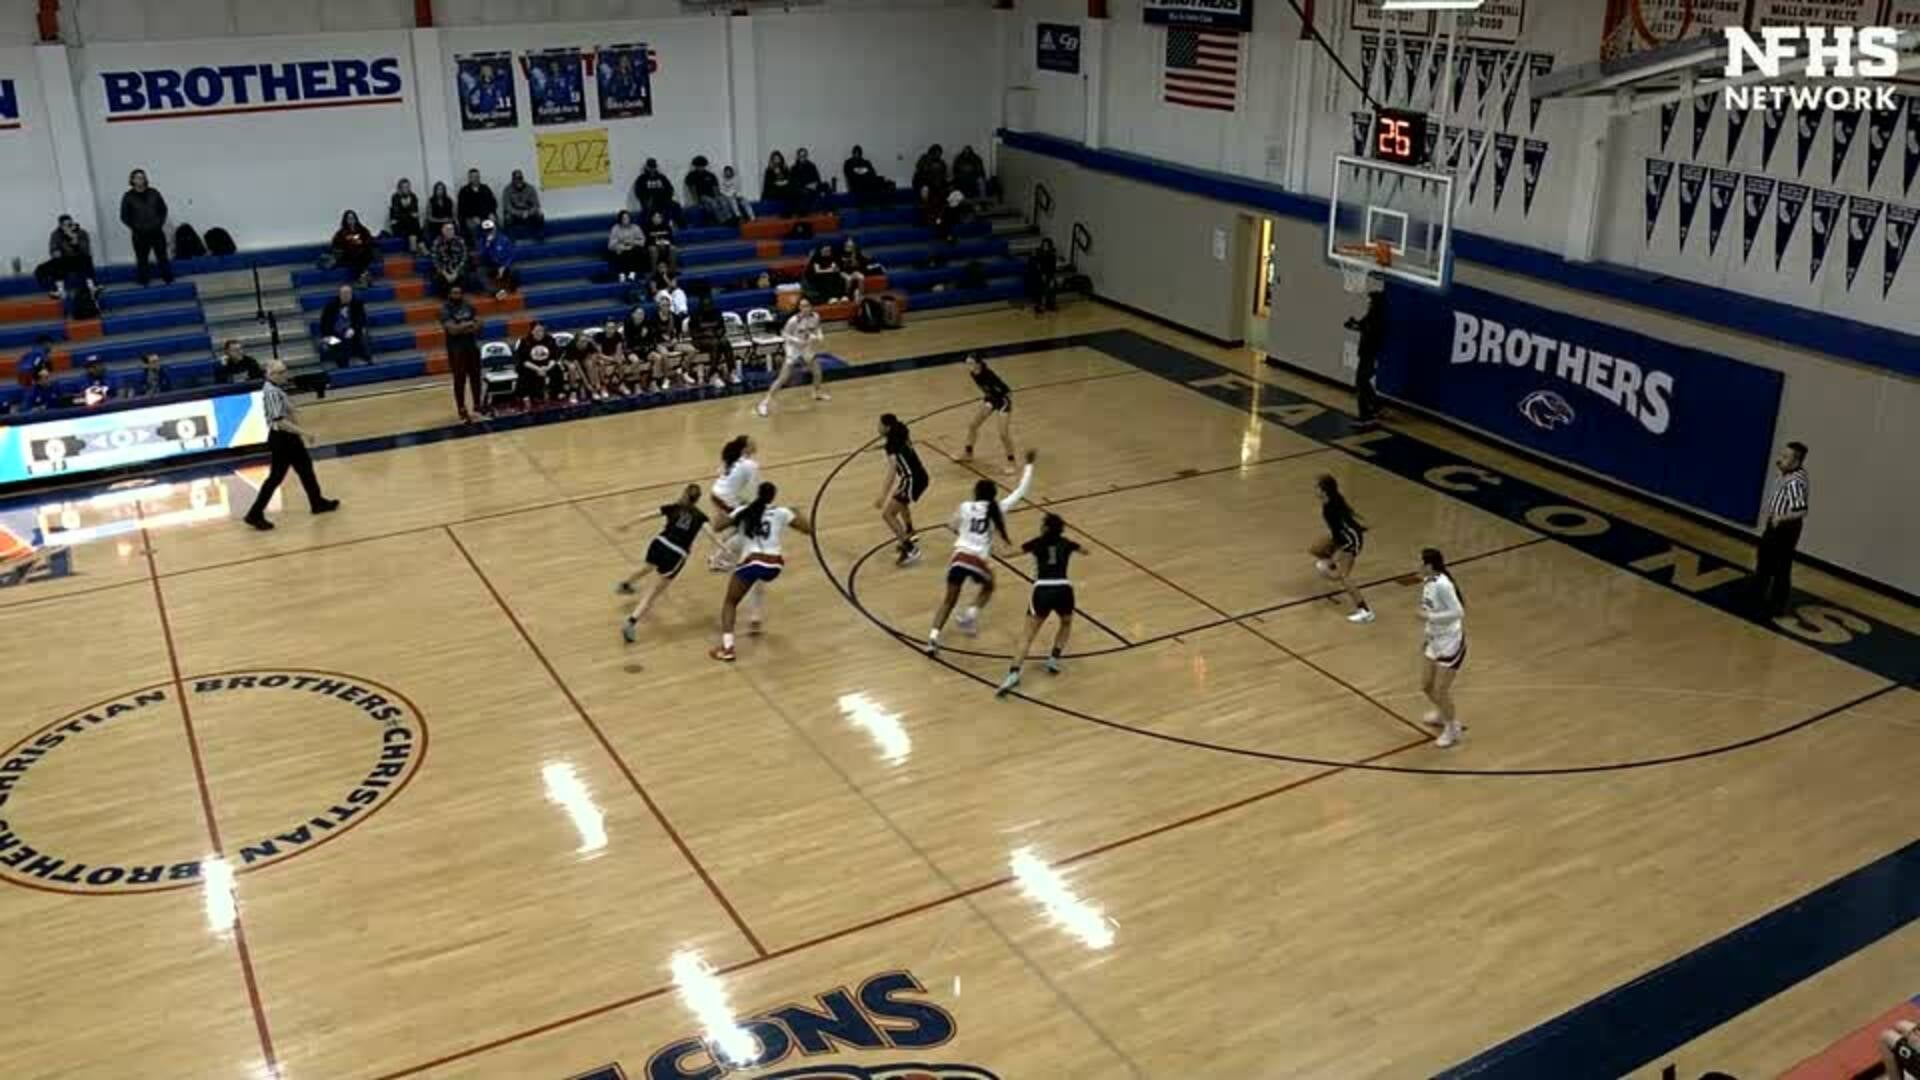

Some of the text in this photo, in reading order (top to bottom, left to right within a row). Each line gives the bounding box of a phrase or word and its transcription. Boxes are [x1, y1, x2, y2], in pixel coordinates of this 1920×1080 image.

[101, 57, 402, 112] BROTHERS
[542, 140, 609, 175] 2027
[1379, 117, 1411, 156] 26
[1450, 310, 1675, 435] BROTHERS
[969, 517, 989, 535] 10
[1190, 371, 1873, 645] FALCONS
[193, 673, 402, 722] BROTHERS
[240, 725, 412, 864] CHRISTIAN
